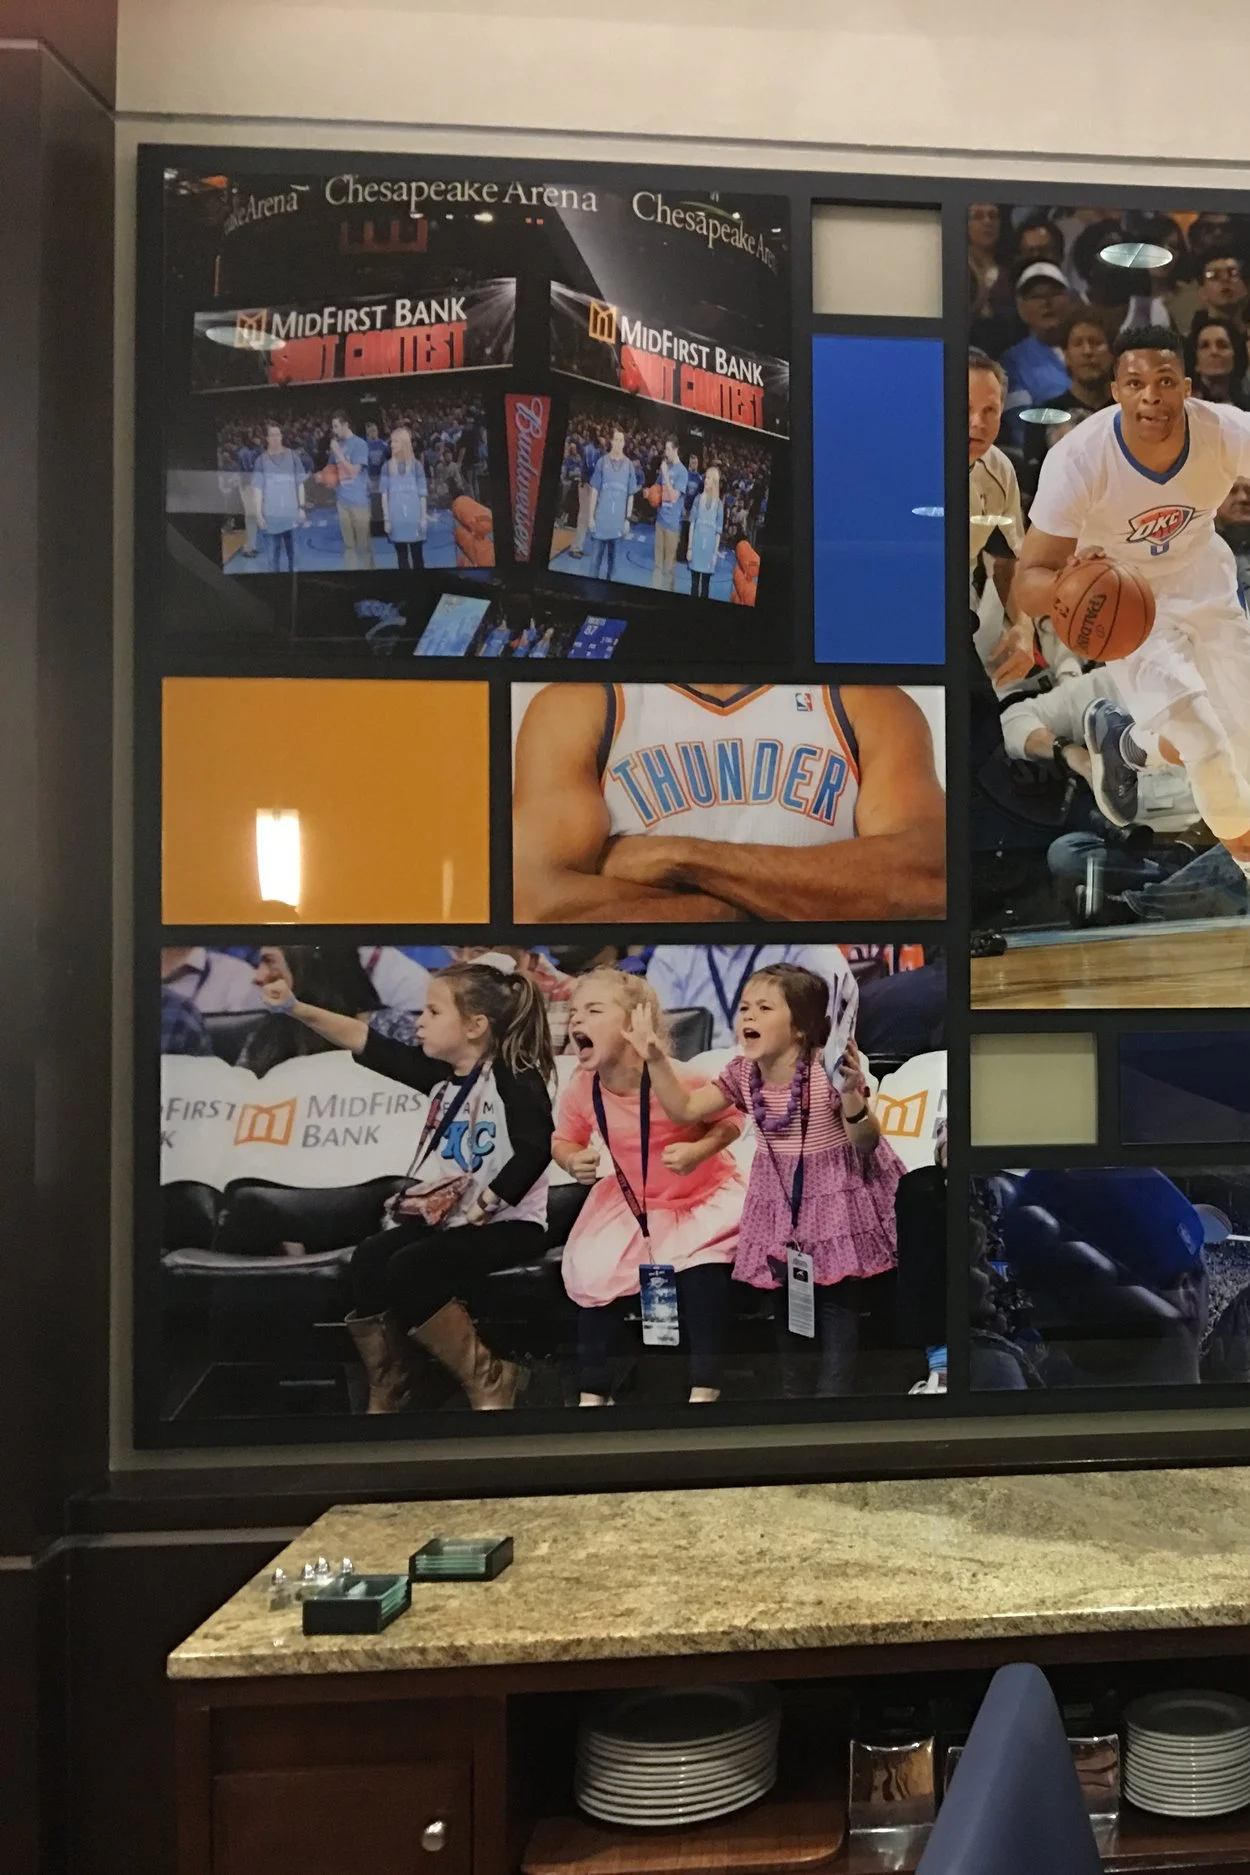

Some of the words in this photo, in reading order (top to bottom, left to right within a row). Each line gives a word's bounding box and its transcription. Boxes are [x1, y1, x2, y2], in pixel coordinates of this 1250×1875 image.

[244, 191, 298, 223] Arena
[325, 174, 499, 214] Chesapeake
[502, 181, 599, 212] Arena
[632, 191, 756, 255] Chesapeake
[395, 296, 467, 327] BANK
[715, 346, 764, 387] BANK
[514, 397, 544, 557] Budweiser
[1127, 511, 1180, 542] OKC
[609, 738, 849, 828] THUNDER
[160, 1097, 237, 1122] FIRST
[306, 1092, 424, 1120] MIDFIRS
[301, 1124, 381, 1148] BANK
